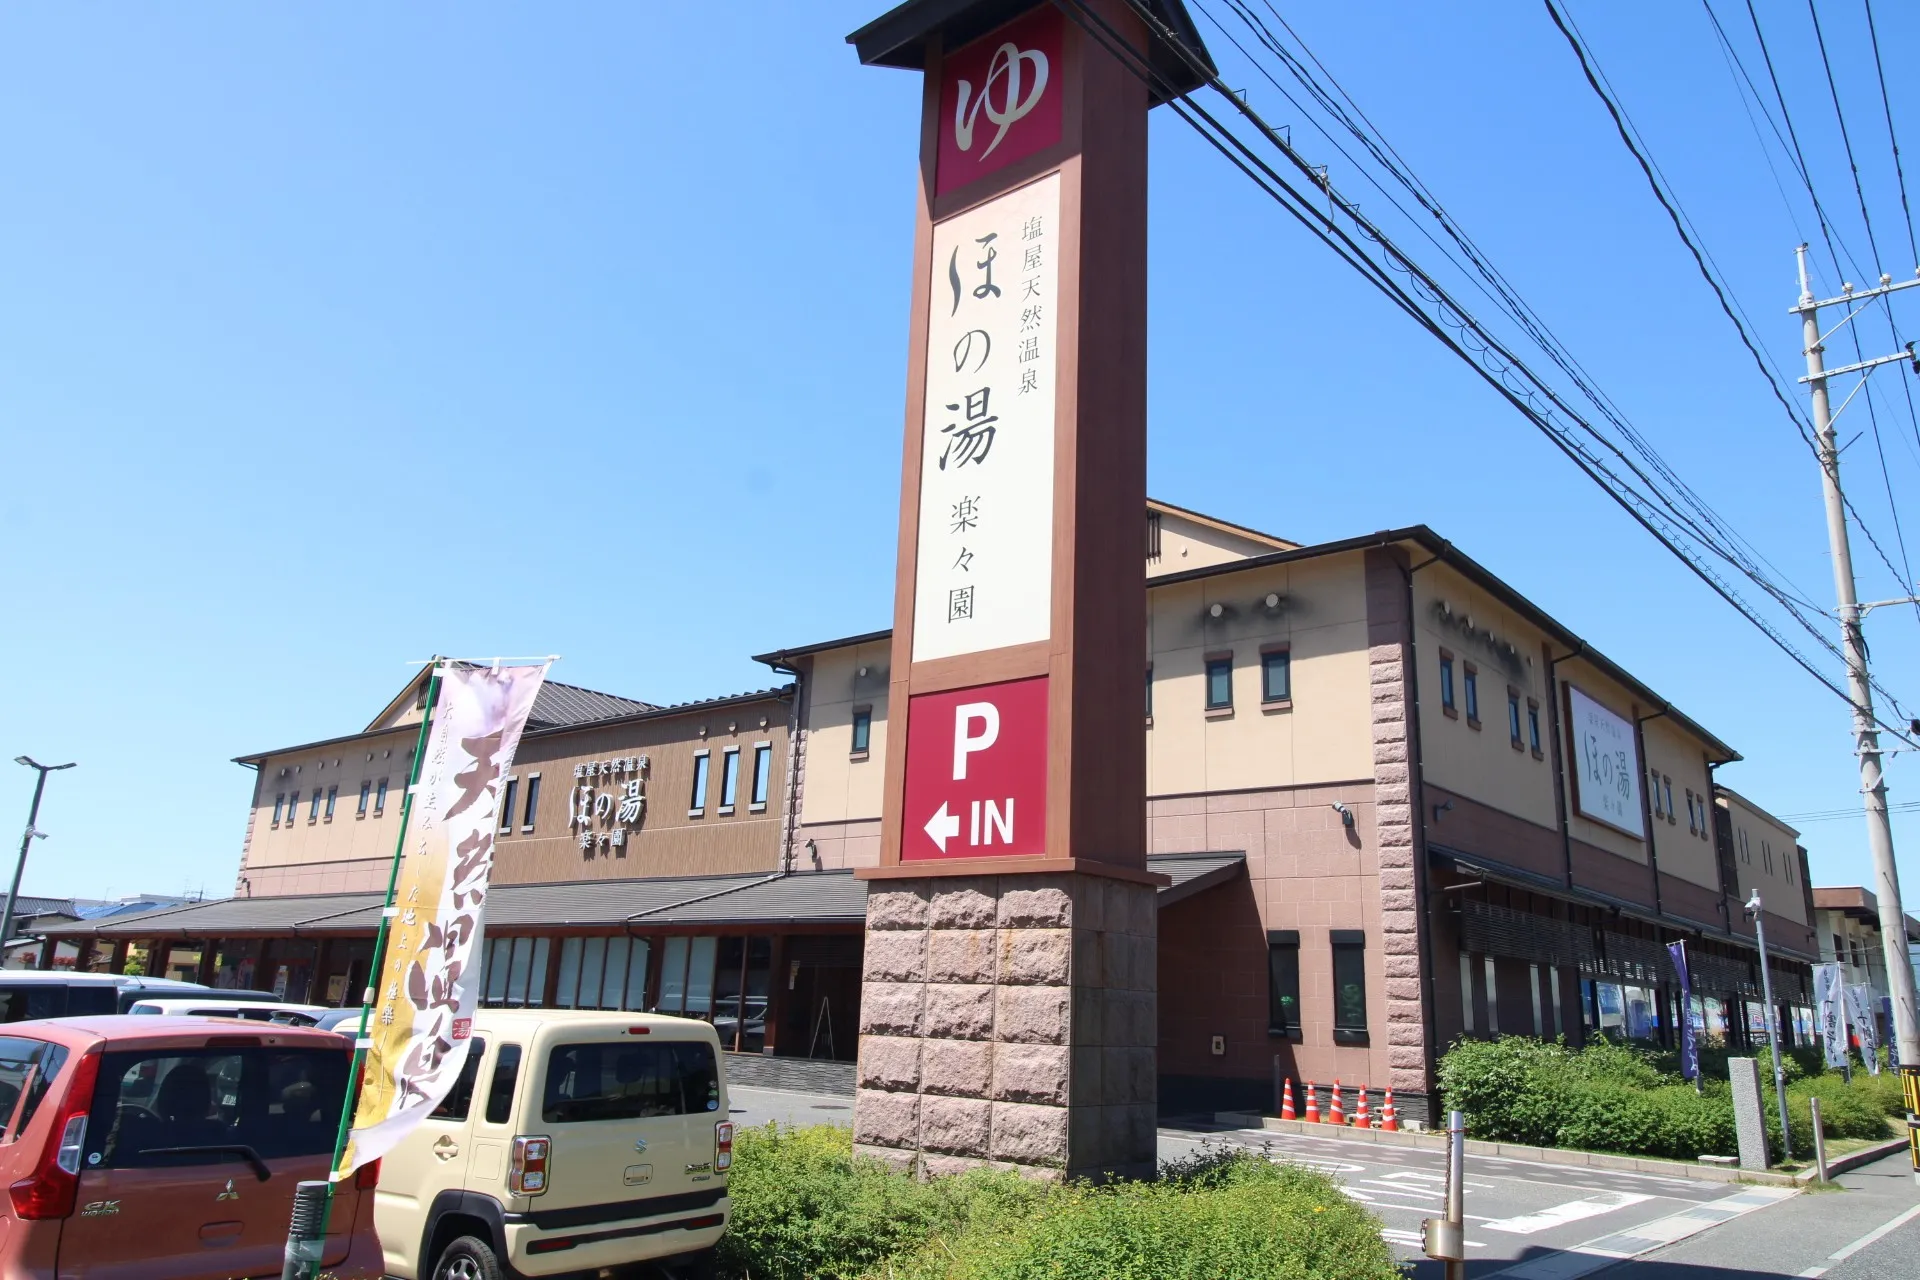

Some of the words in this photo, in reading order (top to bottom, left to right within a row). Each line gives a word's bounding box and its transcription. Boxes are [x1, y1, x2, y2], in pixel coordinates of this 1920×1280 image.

[955, 42, 1049, 162] ゆ
[1018, 216, 1043, 396] 塩屋天然温泉
[938, 232, 1002, 471] ほの湯
[947, 495, 981, 624] 楽々園
[573, 753, 650, 778] 塩屋天然温泉
[952, 701, 1000, 781] P
[1583, 730, 1630, 800] ほの湯
[568, 778, 648, 828] ほの湯
[579, 827, 628, 849] 楽々園
[970, 798, 1014, 847] IN
[399, 727, 504, 1110] 天然温泉
[453, 1020, 471, 1038] 湯
